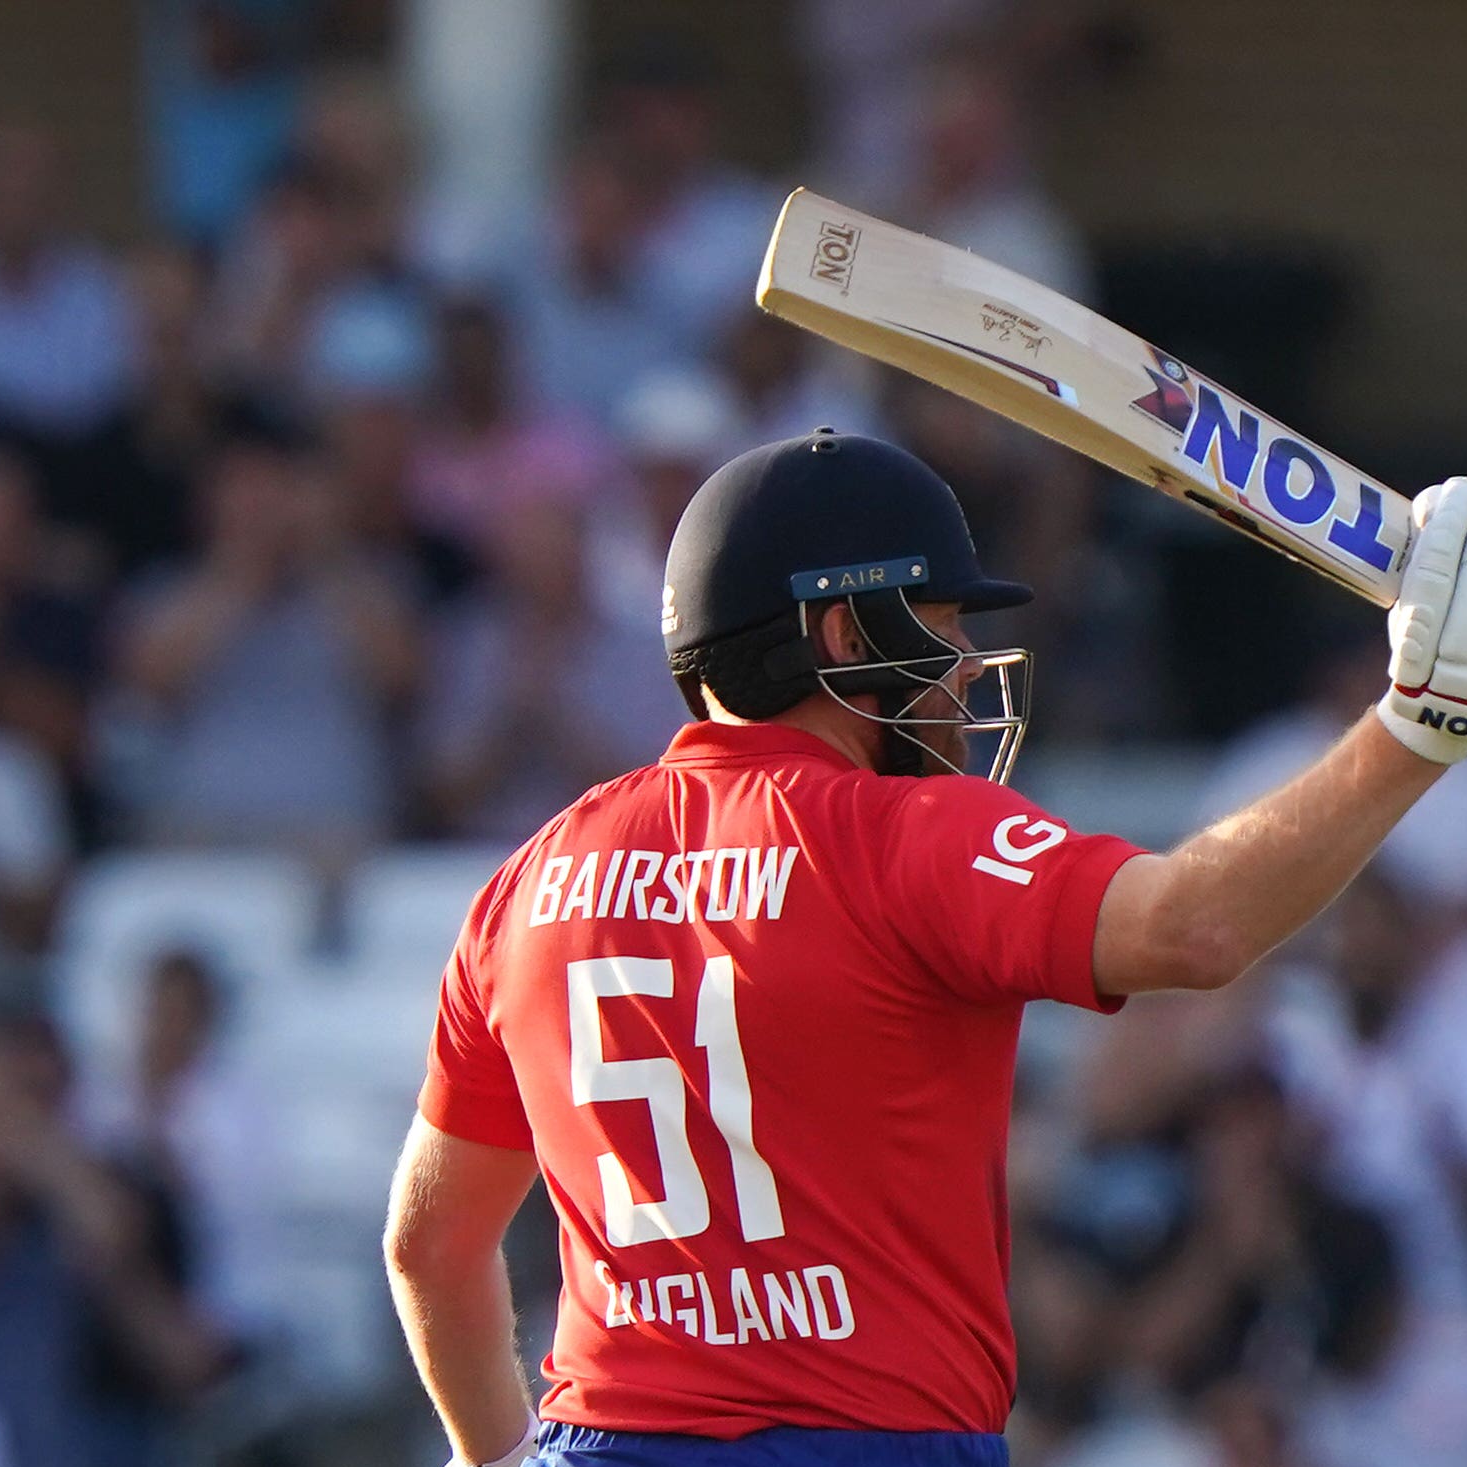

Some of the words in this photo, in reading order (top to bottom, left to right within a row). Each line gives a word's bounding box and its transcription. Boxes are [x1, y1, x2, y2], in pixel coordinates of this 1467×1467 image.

[813, 225, 858, 287] TON
[1183, 383, 1395, 575] TON
[839, 567, 885, 588] AIR
[529, 846, 799, 928] BAIRSTOW
[972, 814, 1066, 885] IG
[567, 955, 785, 1249] 51
